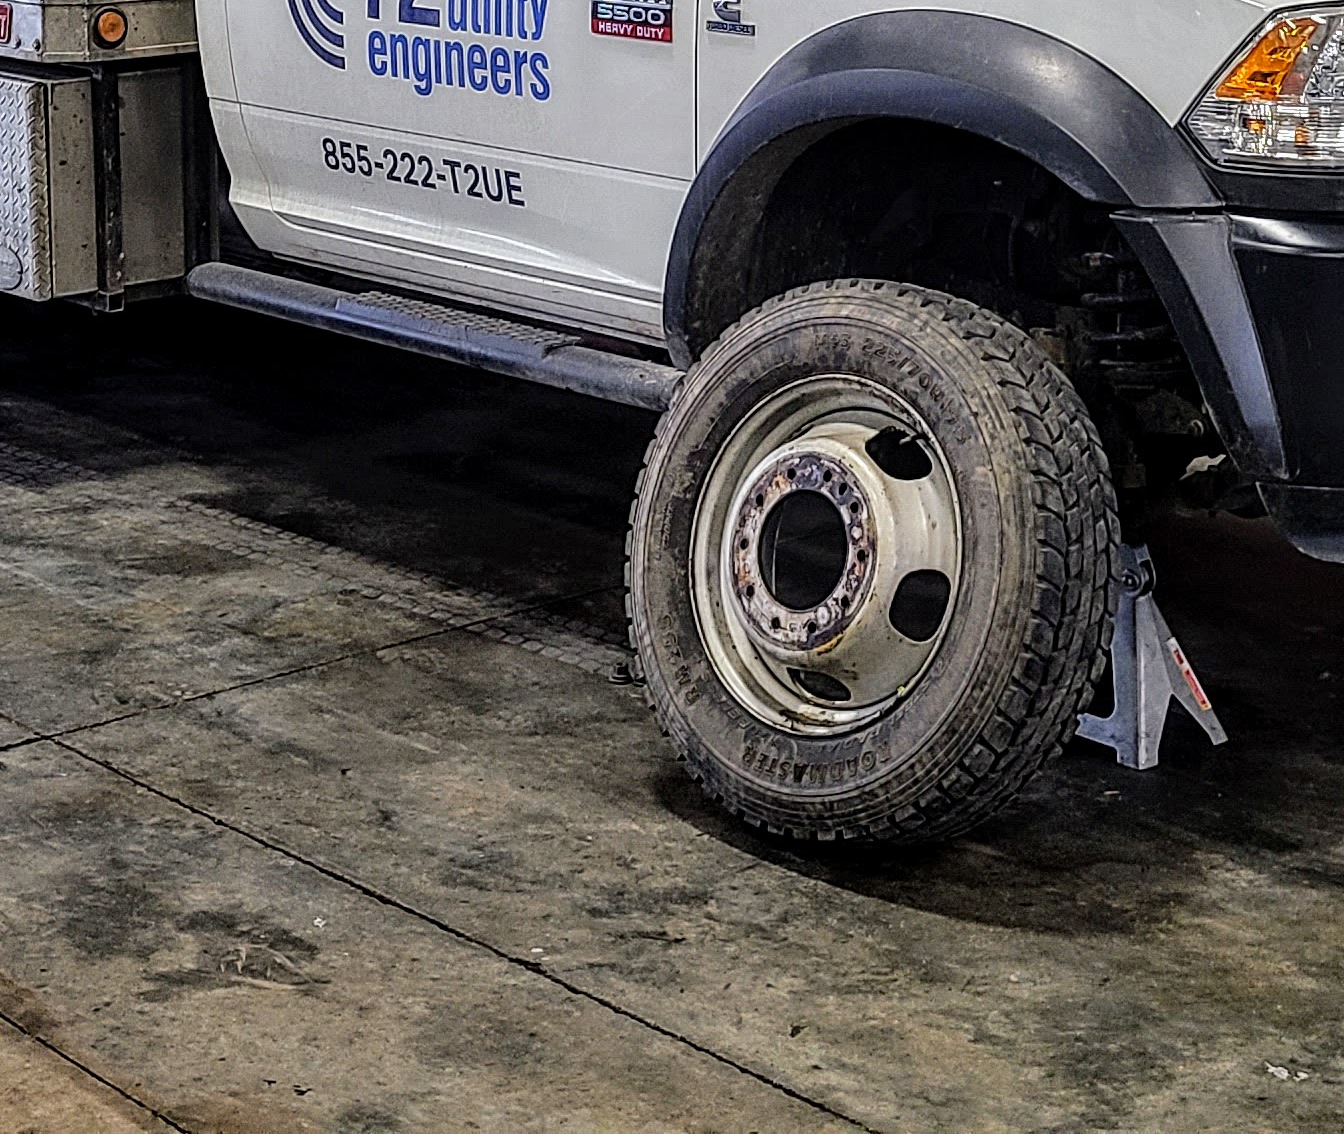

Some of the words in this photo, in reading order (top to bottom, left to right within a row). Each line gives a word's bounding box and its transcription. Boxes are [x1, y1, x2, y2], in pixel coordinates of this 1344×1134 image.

[597, 3, 666, 25] 5500
[598, 21, 633, 36] HEAVY
[636, 26, 665, 40] DUTY
[367, 30, 551, 101] engineers
[322, 137, 526, 208] 855-222-T2UE
[742, 742, 892, 785] ROADMASTER
